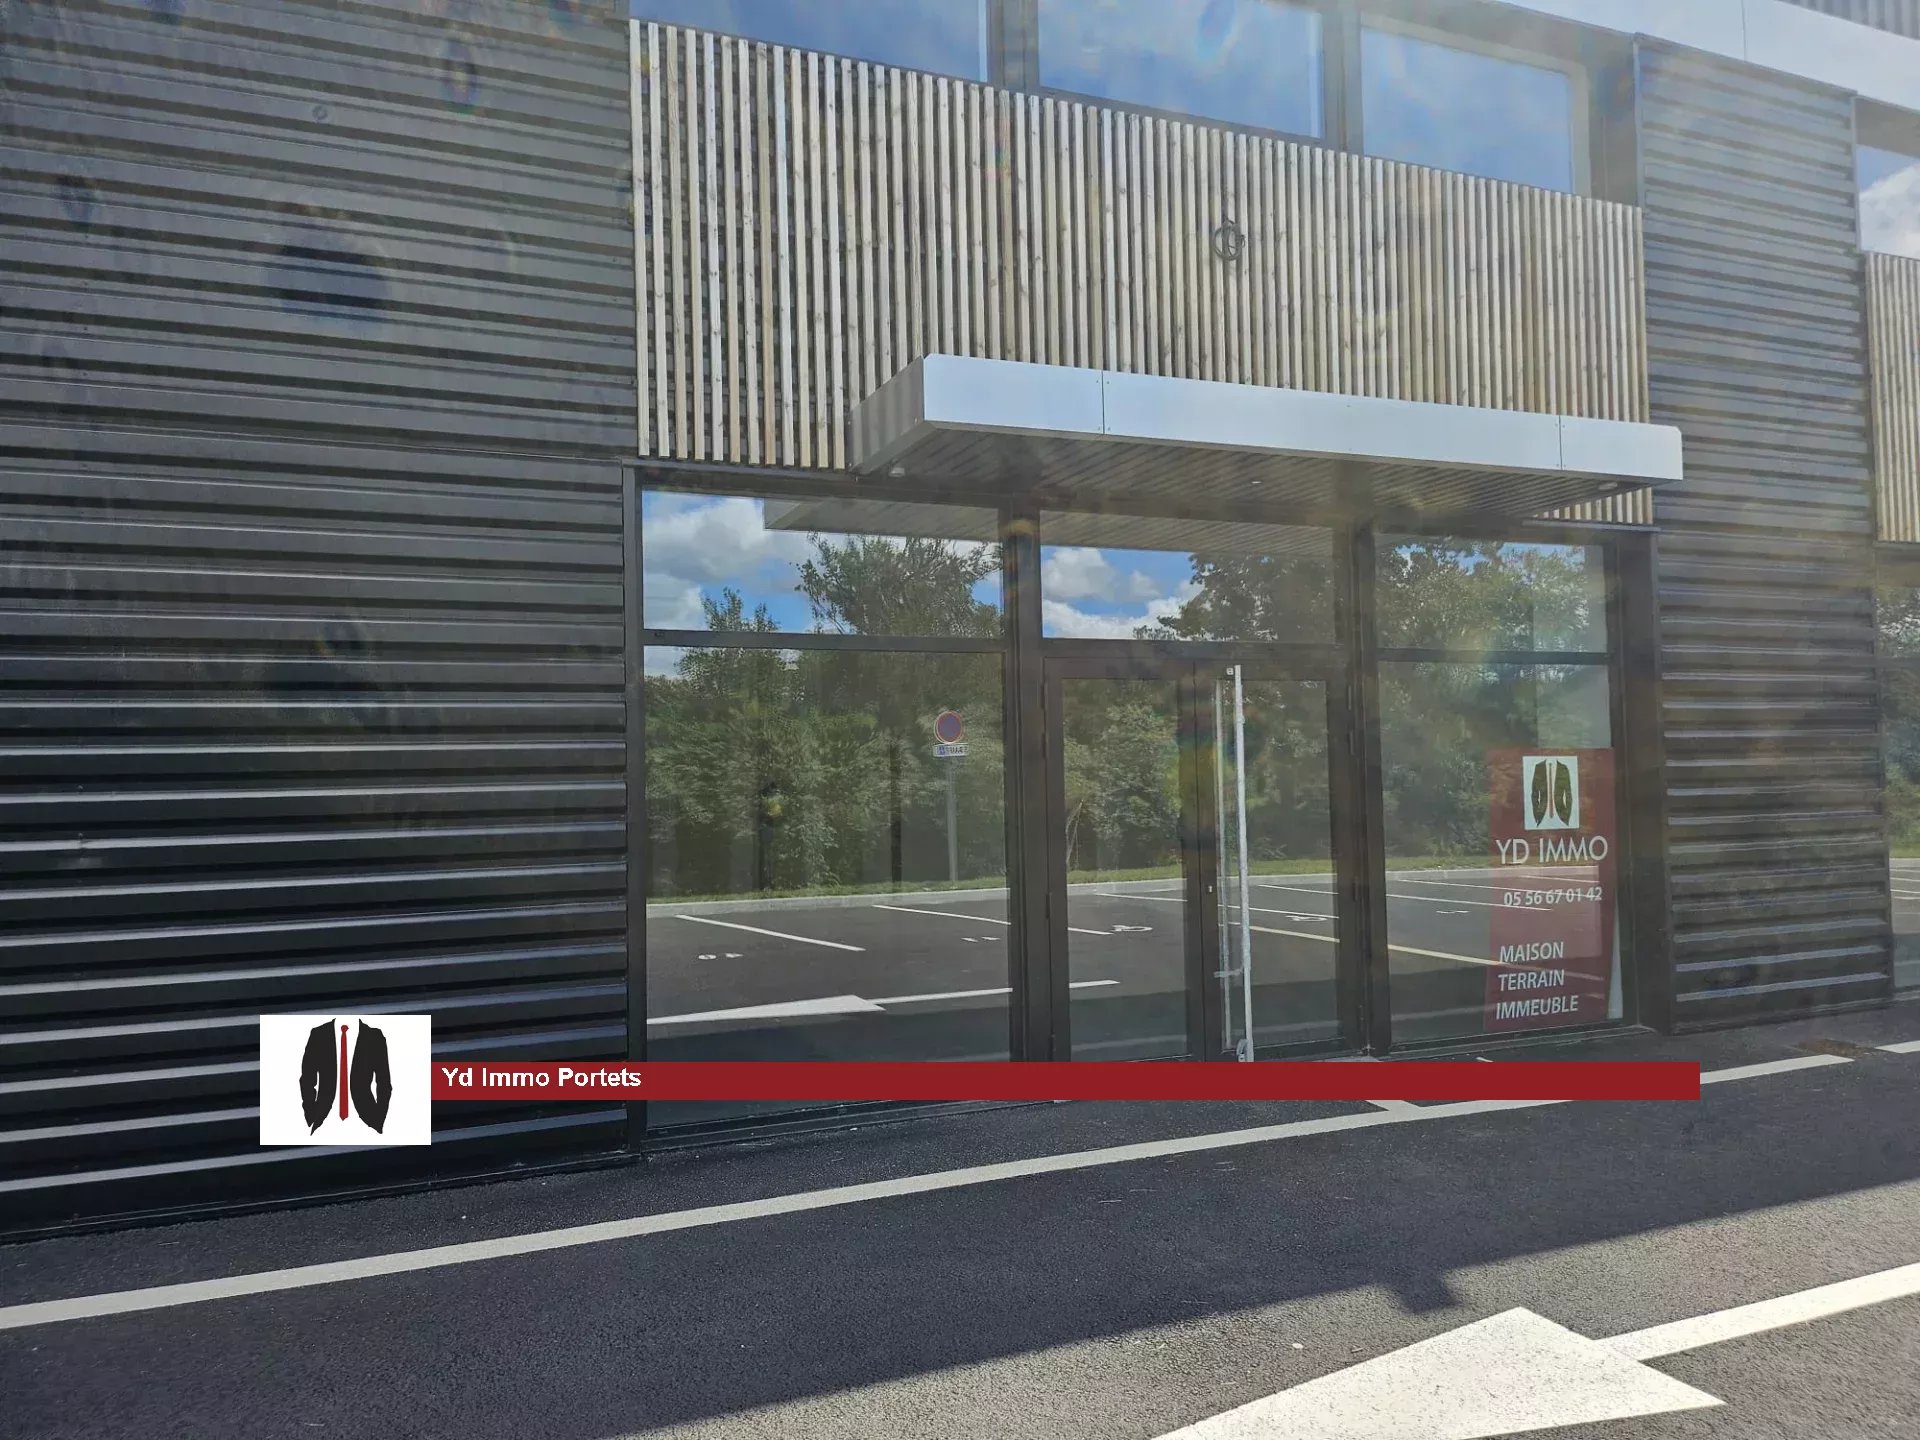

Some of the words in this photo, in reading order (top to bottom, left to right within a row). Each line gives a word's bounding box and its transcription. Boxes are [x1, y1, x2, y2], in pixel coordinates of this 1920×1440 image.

[1496, 838, 1530, 865] YD
[1539, 836, 1608, 863] IMMO
[1503, 891, 1521, 907] 05
[1525, 890, 1542, 905] 56
[1546, 889, 1563, 904] 67
[1566, 888, 1582, 903] 01
[1586, 886, 1603, 901] 42
[1499, 942, 1564, 963] MAISON
[1498, 970, 1565, 991] TERRAIN
[1496, 995, 1579, 1020] IMMEUBLE
